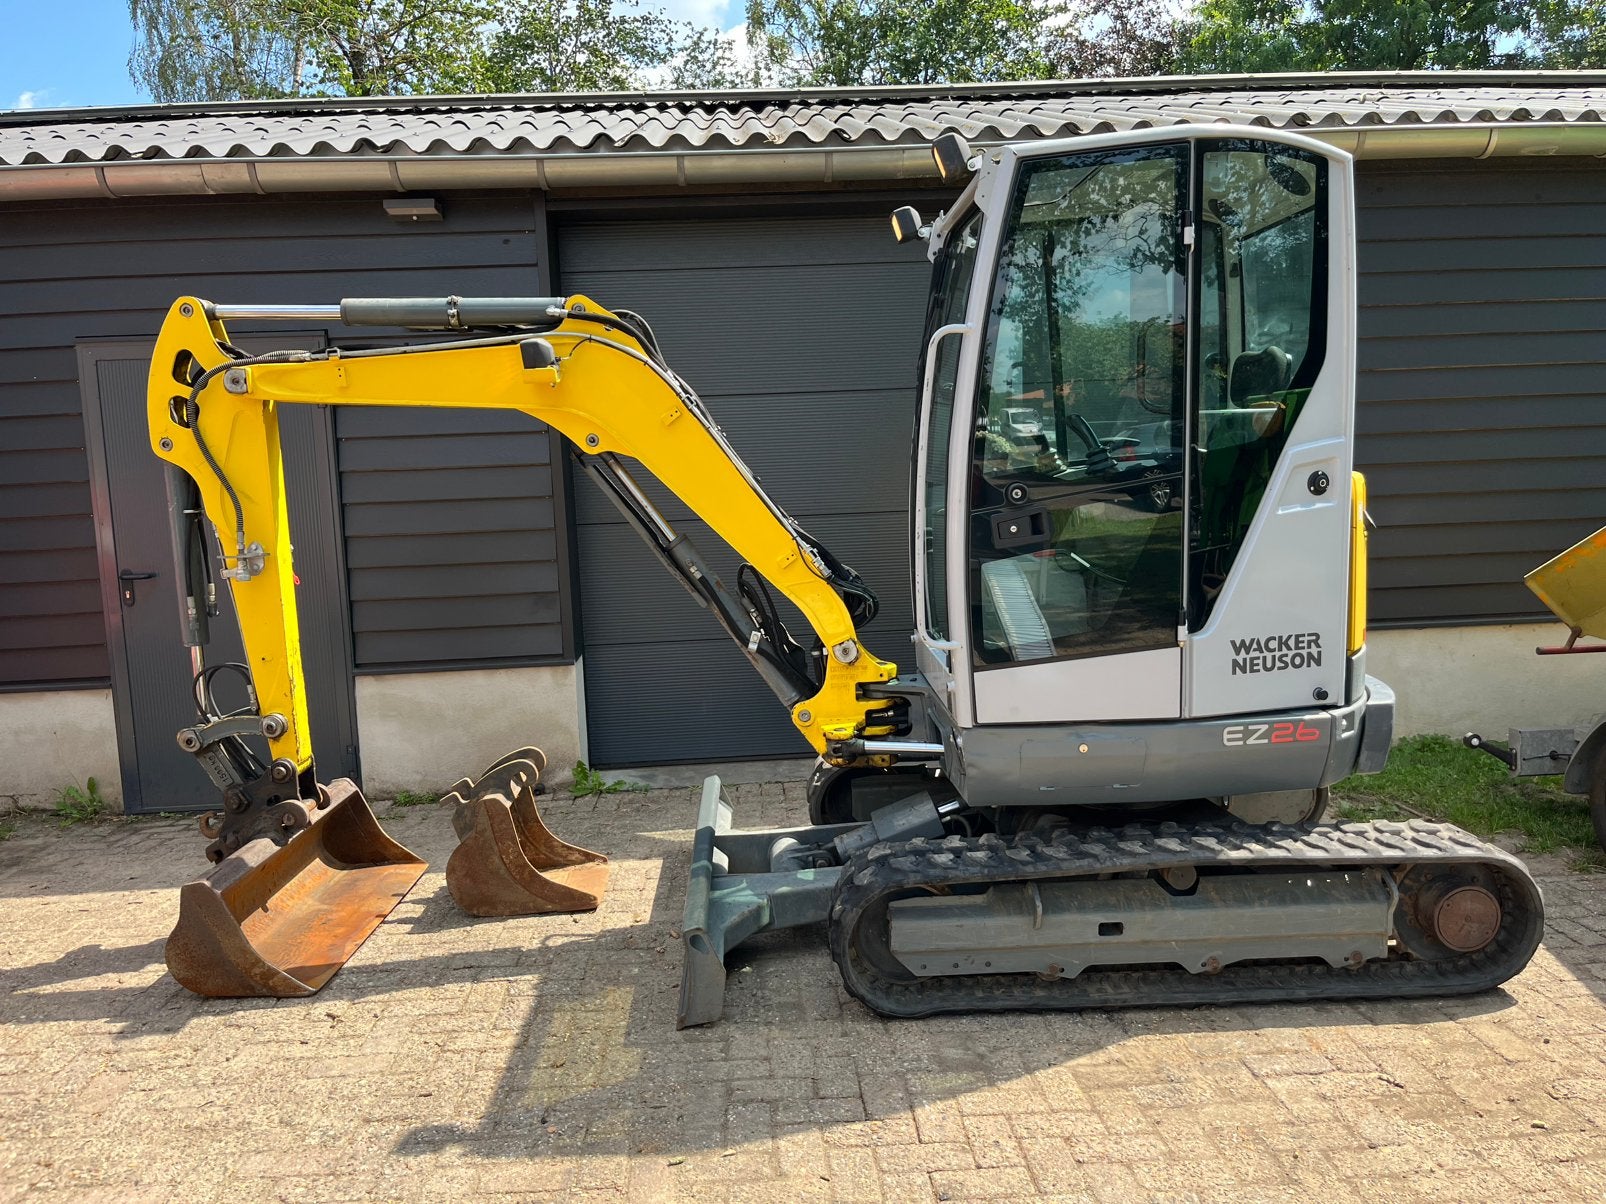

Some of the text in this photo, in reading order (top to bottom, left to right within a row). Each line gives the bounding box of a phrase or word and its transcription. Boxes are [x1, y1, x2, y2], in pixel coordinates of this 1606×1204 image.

[1230, 632, 1322, 656] WACKER
[1231, 651, 1321, 675] NEUSON
[1223, 721, 1320, 746] EZ26
